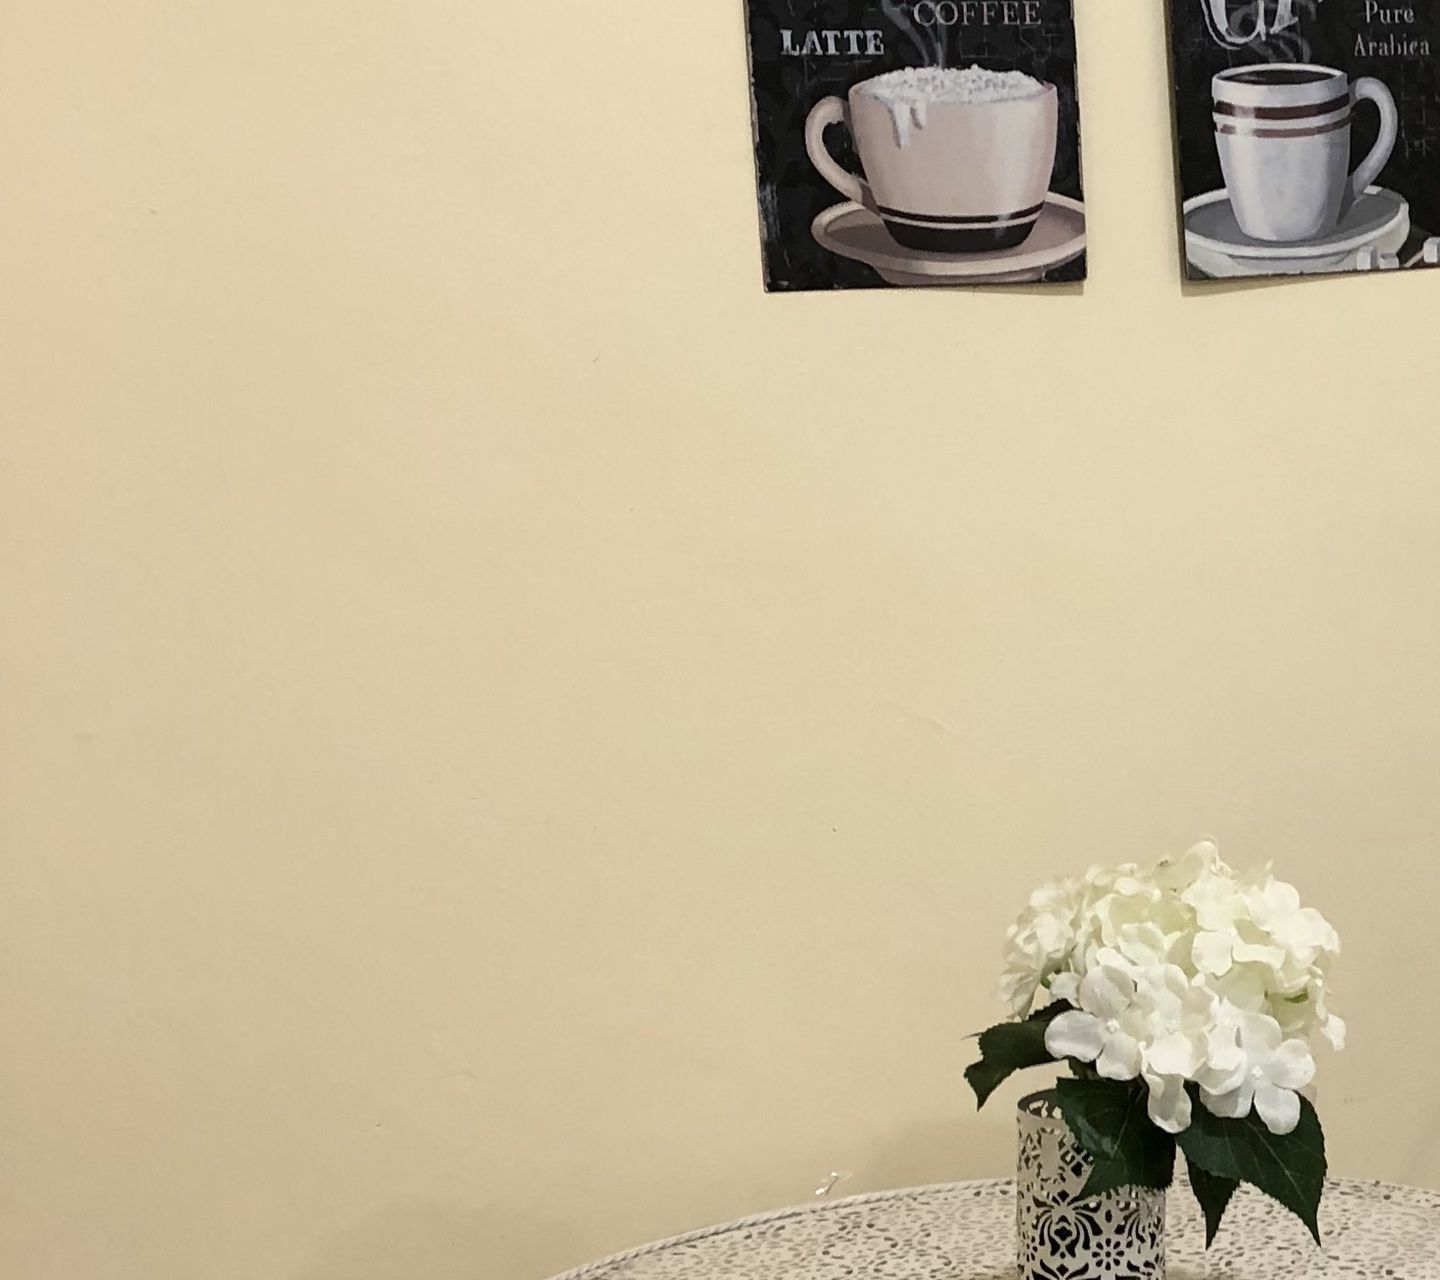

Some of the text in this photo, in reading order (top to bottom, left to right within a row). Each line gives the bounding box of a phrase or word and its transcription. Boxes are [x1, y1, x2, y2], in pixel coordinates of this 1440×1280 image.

[913, 0, 1042, 27] COFFEE
[1365, 0, 1414, 24] Pure
[779, 29, 885, 56] LATTE
[1354, 33, 1431, 57] Arabica
